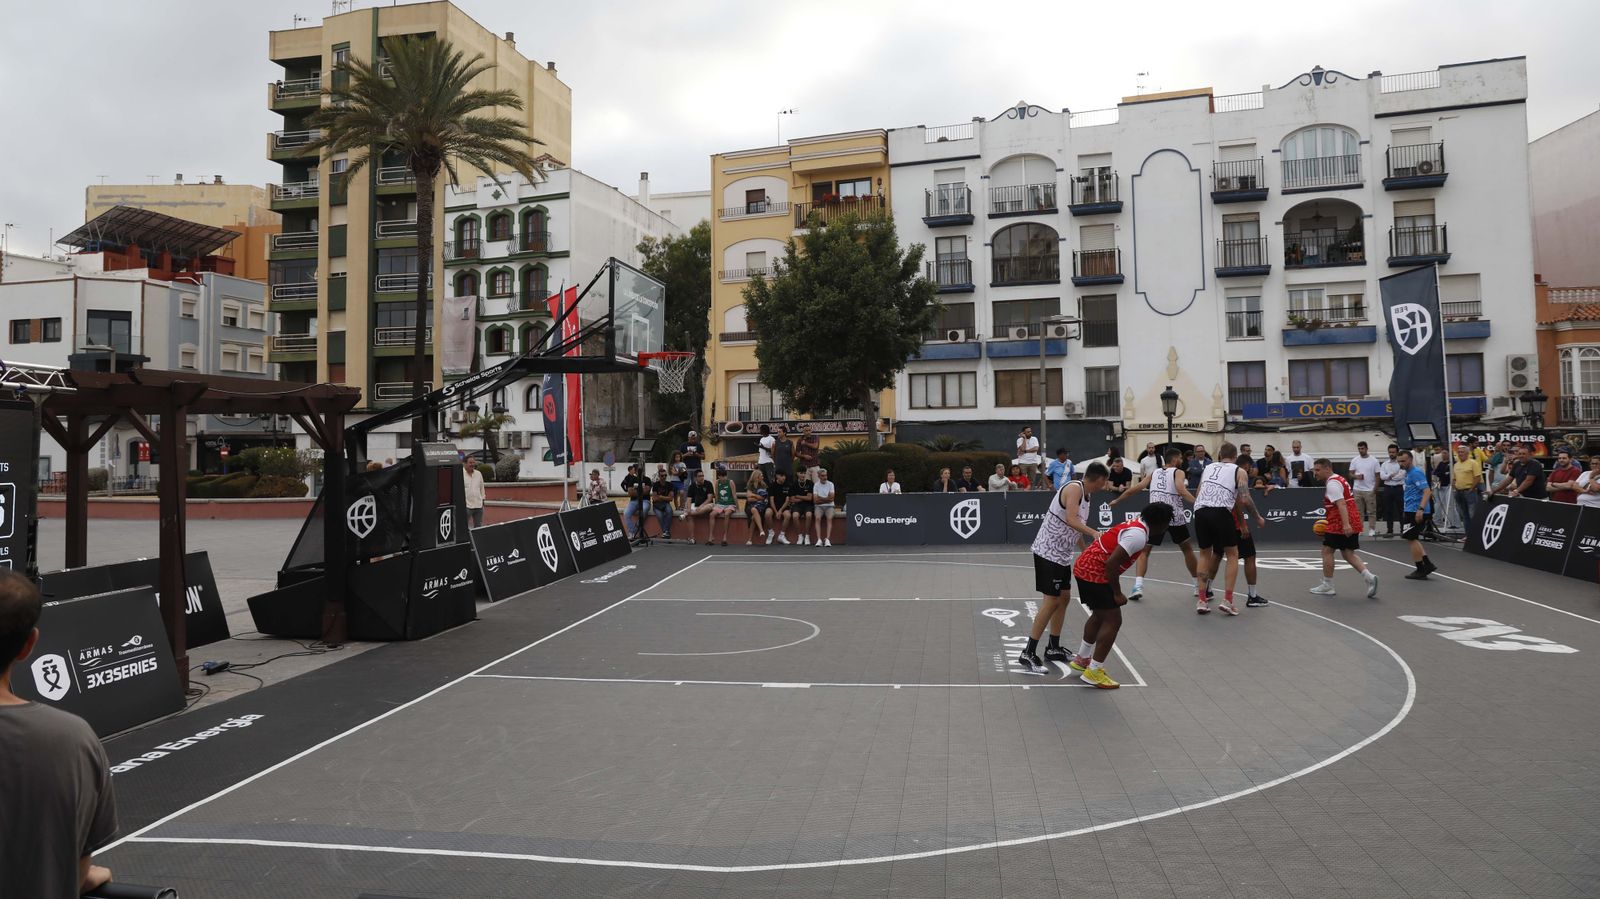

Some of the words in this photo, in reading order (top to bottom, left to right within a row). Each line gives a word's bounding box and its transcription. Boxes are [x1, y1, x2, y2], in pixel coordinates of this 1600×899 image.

[480, 365, 503, 378] Sports
[1299, 402, 1361, 416] OCASO
[1500, 432, 1546, 443] House
[1208, 465, 1223, 481] 1
[863, 516, 886, 525] Gana
[886, 515, 918, 526] Energía
[1015, 512, 1046, 520] ARMAS
[423, 576, 449, 591] ARMAS
[79, 644, 114, 661] ARMAS
[86, 656, 158, 690] 3X3SERIES
[110, 749, 172, 776] ana
